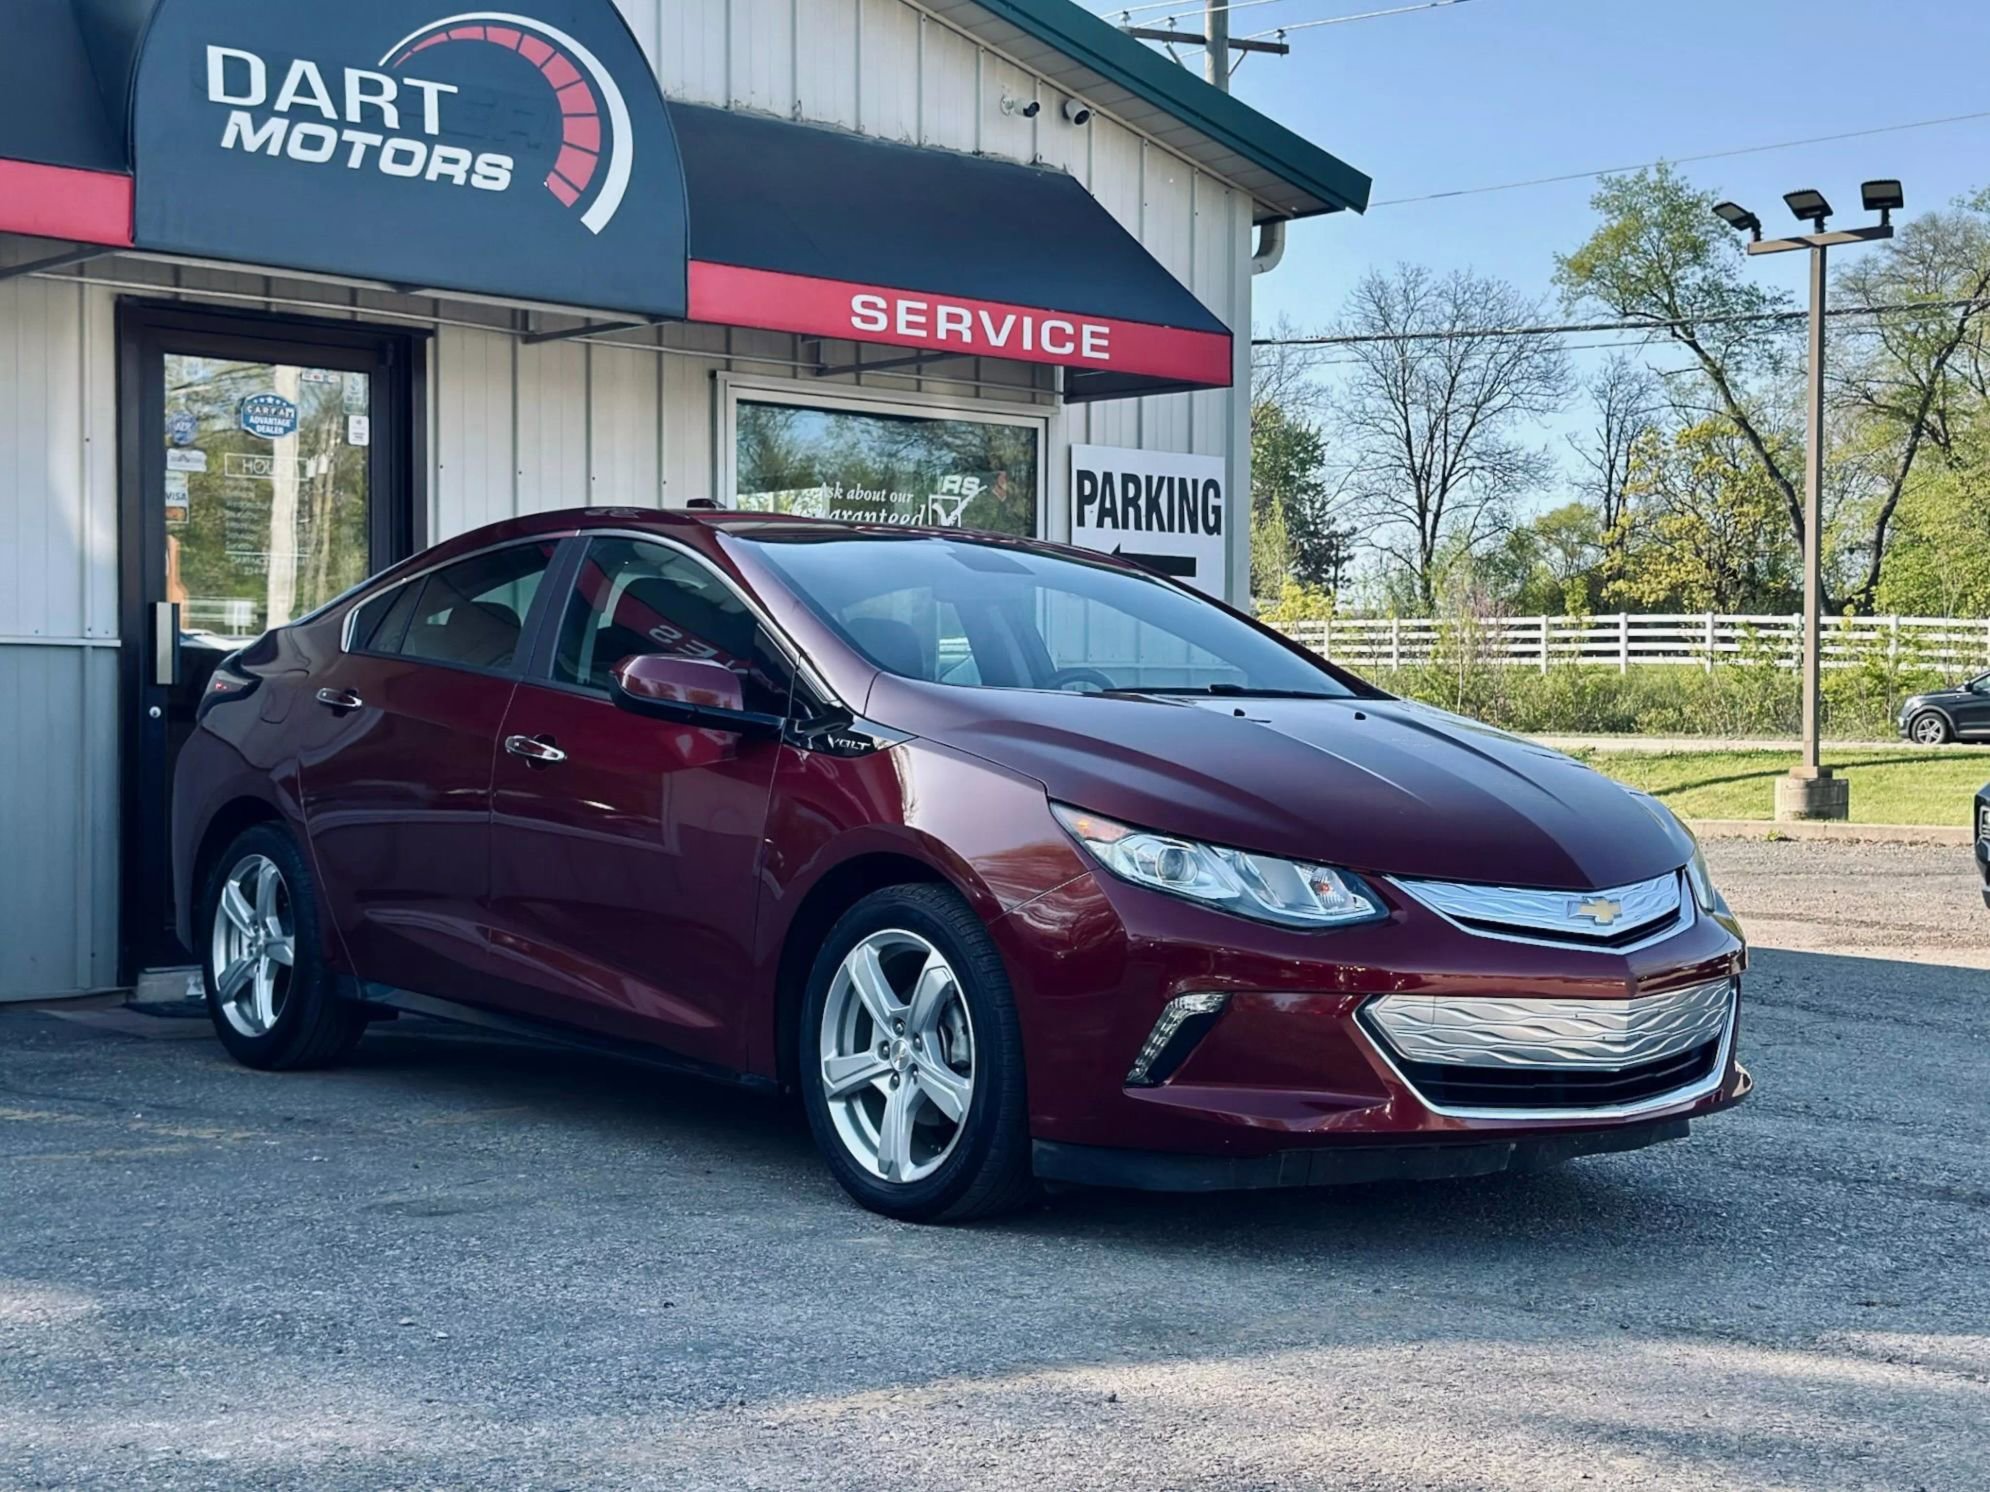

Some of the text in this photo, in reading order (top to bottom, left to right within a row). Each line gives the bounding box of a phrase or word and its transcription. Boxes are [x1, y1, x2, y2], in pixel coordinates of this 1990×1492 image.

[206, 45, 458, 135] DART
[220, 110, 514, 192] MOTORS
[850, 293, 1111, 361] SERVICE
[249, 415, 291, 427] ADVANTAGE
[256, 424, 284, 434] DEALER
[166, 492, 187, 501] VISA
[820, 481, 914, 503] Ask about our
[1076, 469, 1222, 536] PARKING
[827, 733, 871, 750] VOLT
